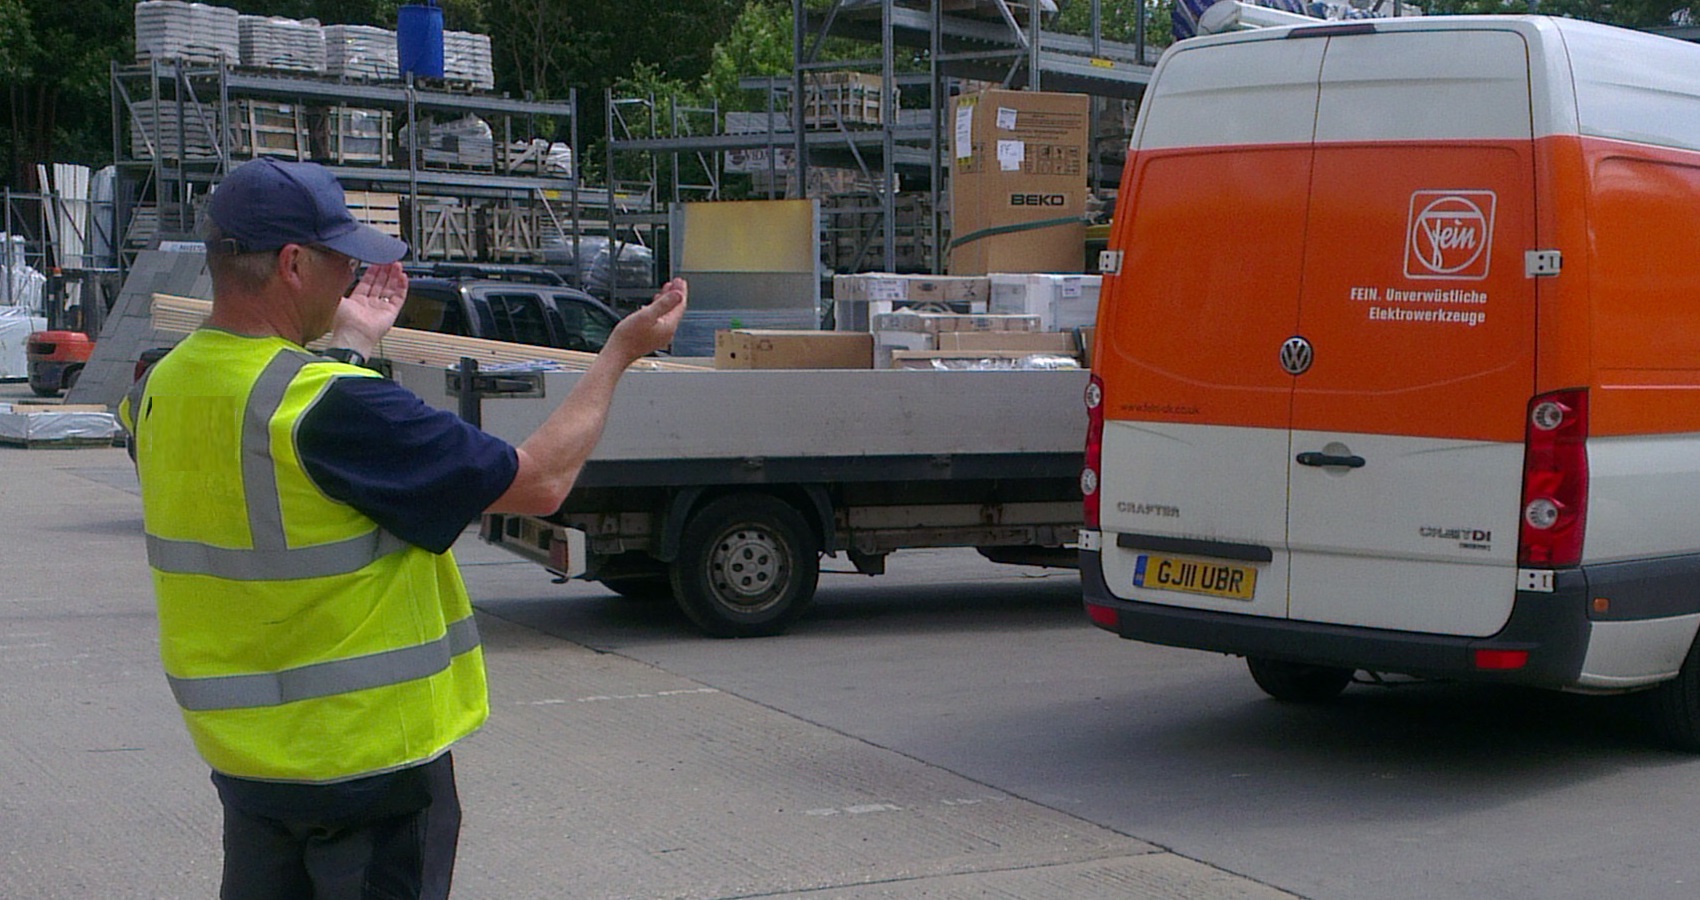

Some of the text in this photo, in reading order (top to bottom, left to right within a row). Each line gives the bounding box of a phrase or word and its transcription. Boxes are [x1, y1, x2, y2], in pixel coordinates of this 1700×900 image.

[1011, 194, 1065, 206] BEKO
[1386, 288, 1487, 304] Unverwüstliche
[1369, 306, 1486, 326] Elektrowerkzeuge
[1117, 502, 1180, 517] CRAFTER
[1157, 561, 1244, 593] GJ11 UBR
